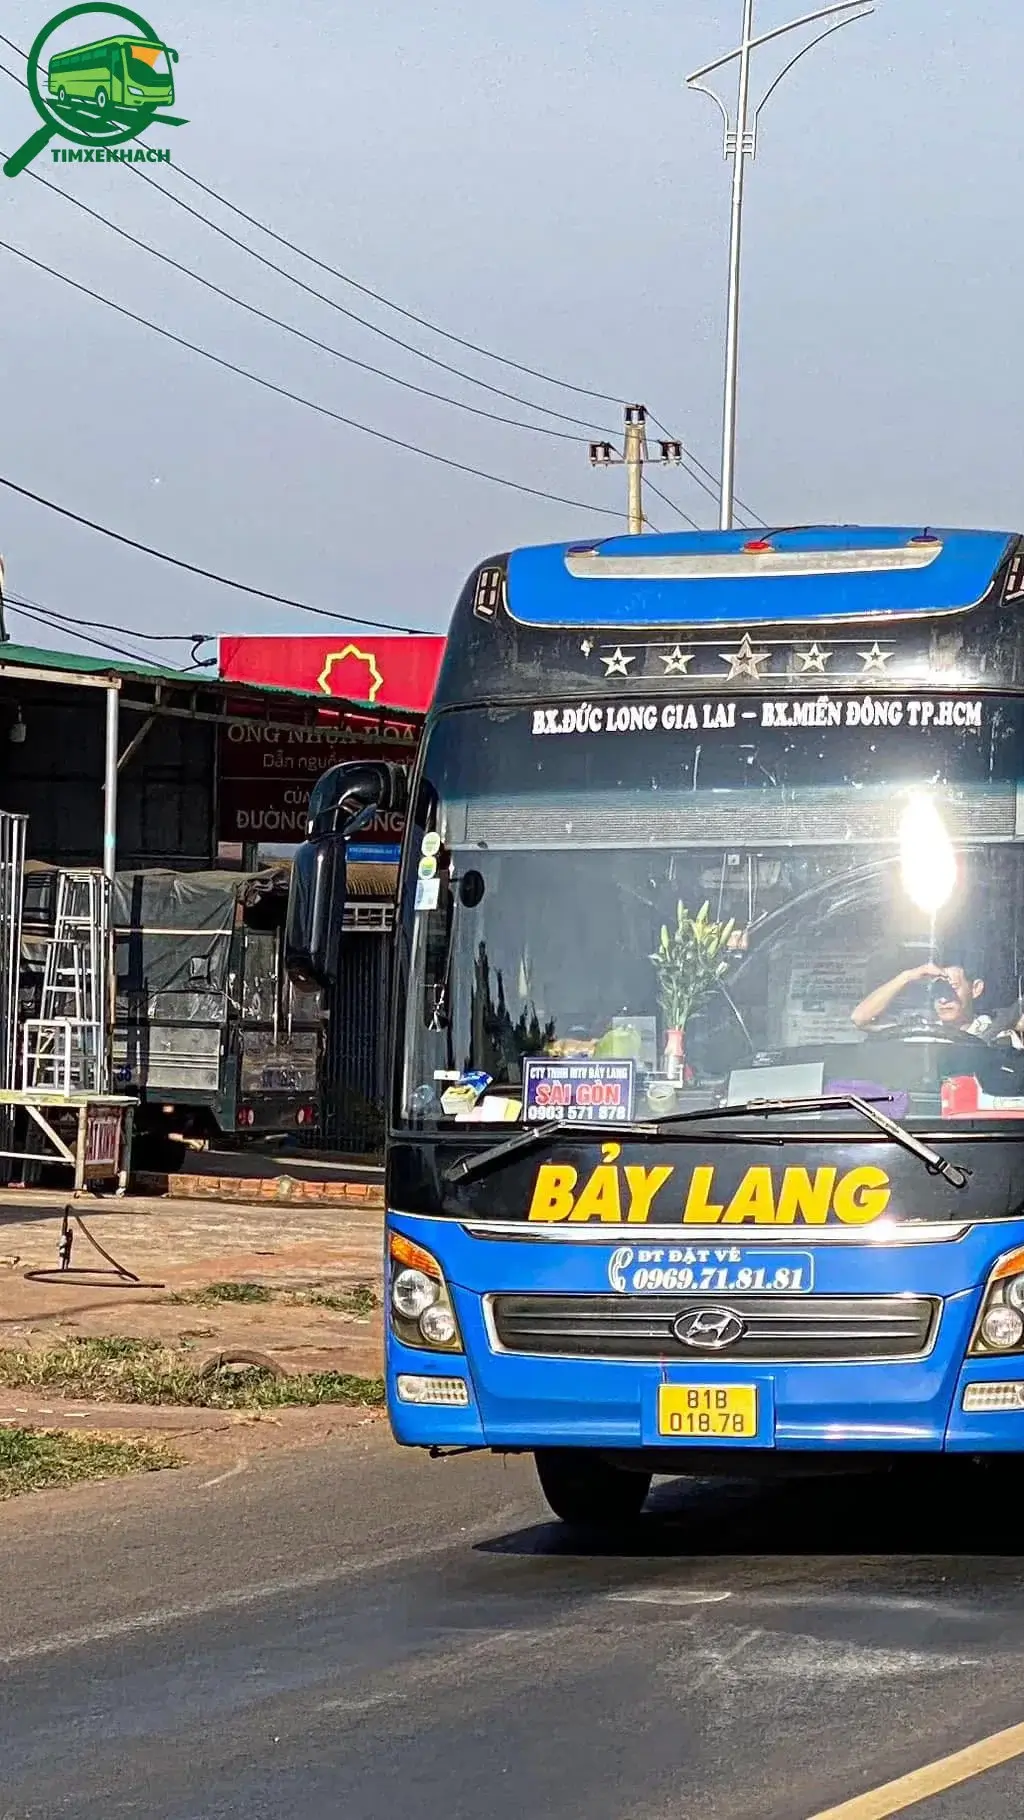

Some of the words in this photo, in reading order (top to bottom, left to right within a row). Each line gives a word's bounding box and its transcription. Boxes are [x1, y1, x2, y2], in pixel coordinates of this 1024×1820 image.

[532, 702, 603, 735] BX.ĐỨC
[605, 705, 657, 732] LONG
[661, 704, 698, 730] GIA
[702, 703, 736, 728] LAI
[845, 695, 903, 727] ĐÔNG
[907, 701, 983, 727] TP.HCM
[530, 1066, 546, 1079] CTY
[535, 1079, 572, 1105] SÀI
[576, 1079, 621, 1105] GÒN
[527, 1105, 564, 1120] 0903
[567, 1105, 593, 1120] 571
[528, 1143, 674, 1223] BẢY
[683, 1166, 891, 1225] LANG
[638, 1249, 665, 1262] ĐT
[632, 1267, 803, 1290] 0969.71.81.81
[687, 1390, 727, 1409] 81B
[670, 1412, 744, 1432] 018.78
